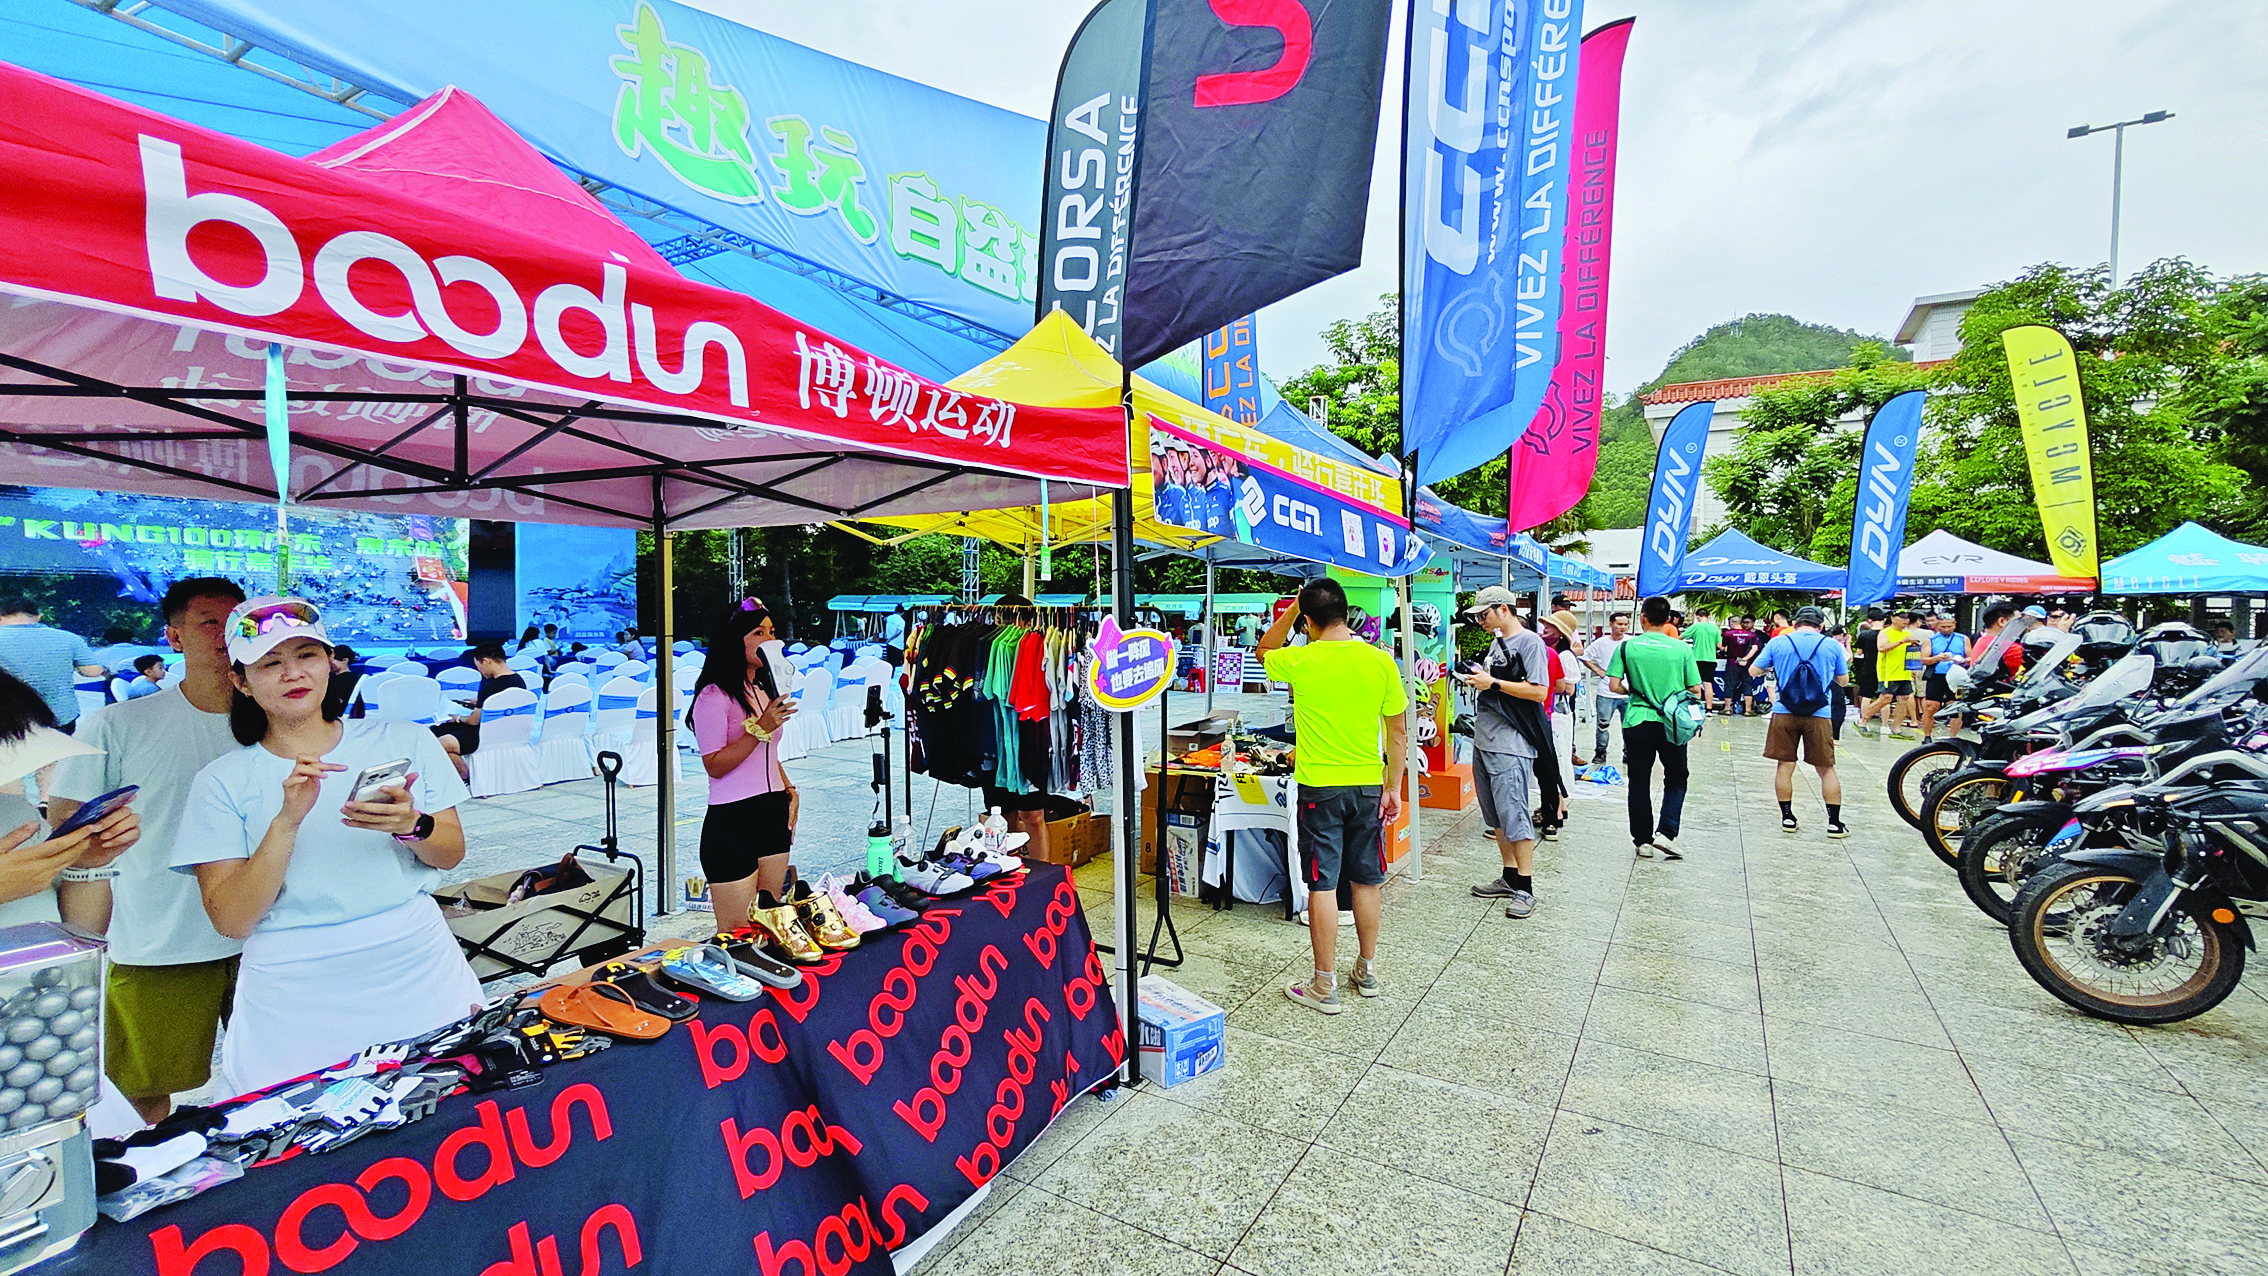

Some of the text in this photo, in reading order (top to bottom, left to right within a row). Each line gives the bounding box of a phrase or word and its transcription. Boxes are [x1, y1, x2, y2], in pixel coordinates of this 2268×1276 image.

[1521, 180, 1554, 240] LA
[1512, 249, 1549, 371] VIVEZ
[1571, 129, 1608, 455] VIVEZ LA DIFFÉRENCE
[793, 331, 1015, 449] 博顿运动
[2028, 347, 2082, 486] MCYCLE
[1651, 447, 1691, 568] DYN
[1860, 441, 1901, 571] DYN
[1743, 571, 1798, 585] 戴恩头盔
[1969, 576, 1998, 584] EXPLORE
[2005, 576, 2029, 584] RIDING
[2113, 574, 2202, 590] MCYCLE
[1110, 656, 1165, 694] 也要去追风
[892, 944, 1009, 1143] boodun
